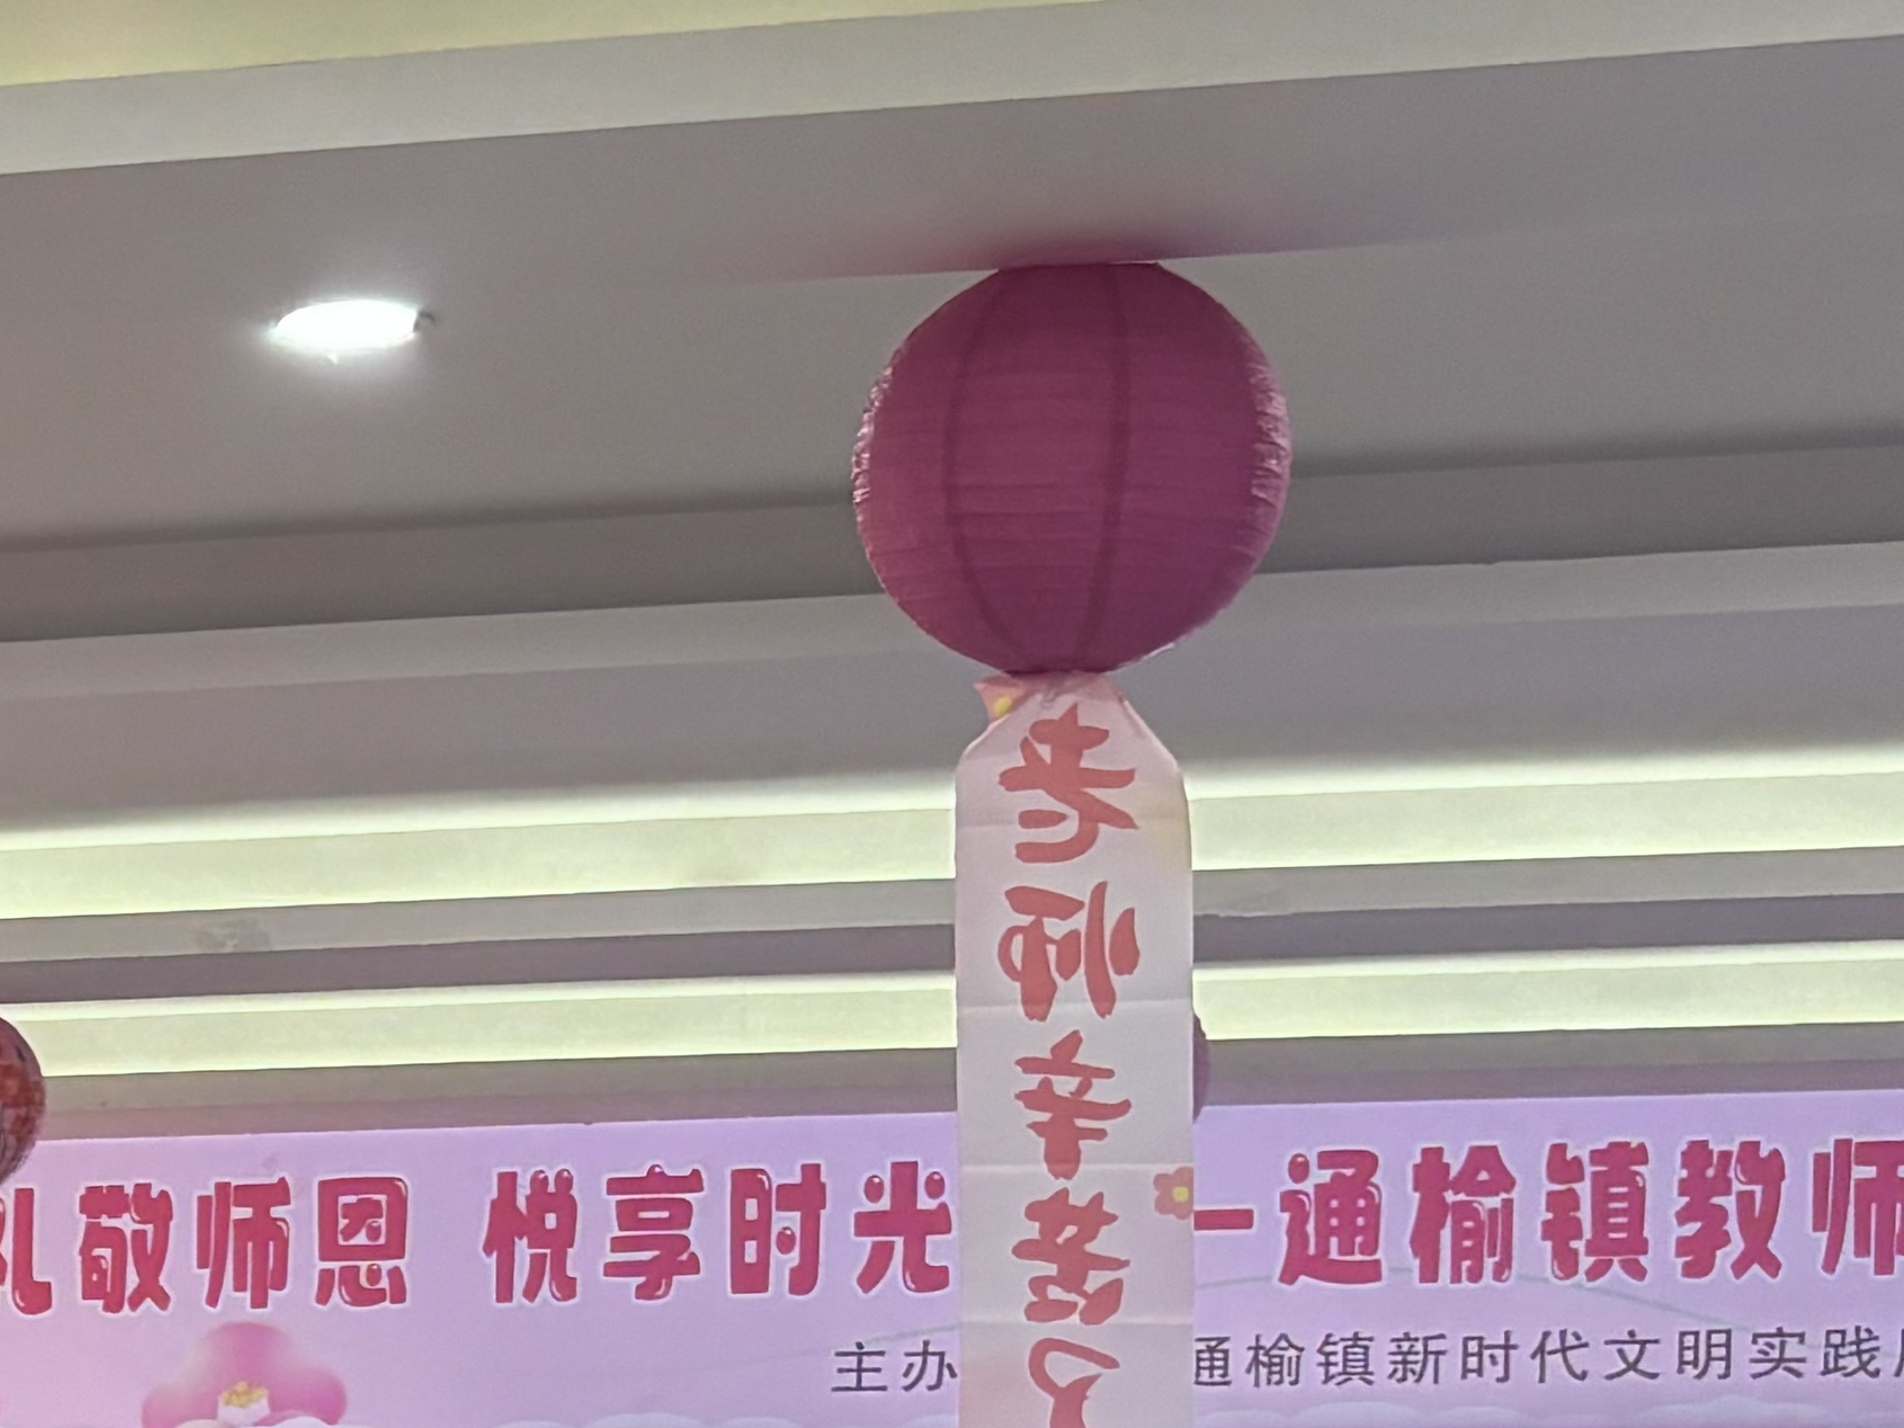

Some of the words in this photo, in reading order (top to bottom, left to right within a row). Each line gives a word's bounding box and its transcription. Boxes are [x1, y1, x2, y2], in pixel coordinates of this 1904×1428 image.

[482, 1159, 951, 1304] 悦享时光
[1193, 1325, 1904, 1388] 通榆镇新时代文明实践
